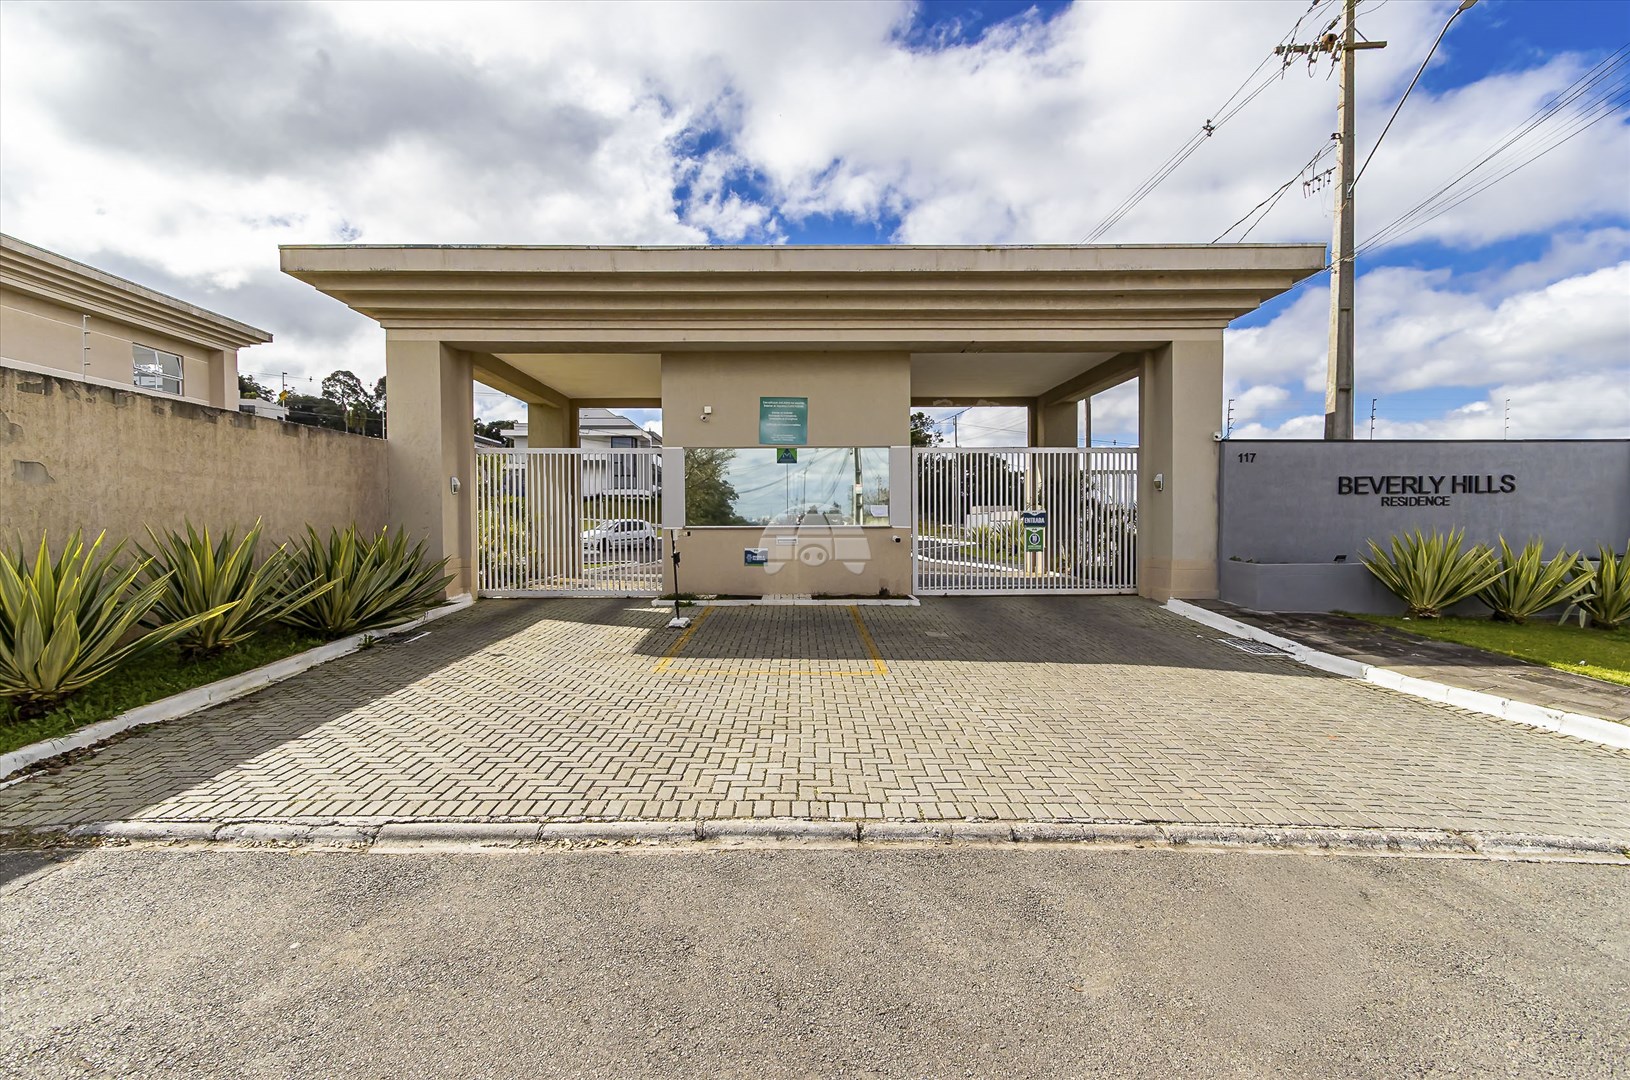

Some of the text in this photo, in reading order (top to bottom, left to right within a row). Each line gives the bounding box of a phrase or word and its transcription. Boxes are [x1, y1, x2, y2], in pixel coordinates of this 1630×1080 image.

[1237, 452, 1256, 463] 117
[1338, 474, 1516, 495] BEVERLY HILLS
[1381, 496, 1450, 507] RESIDENCE
